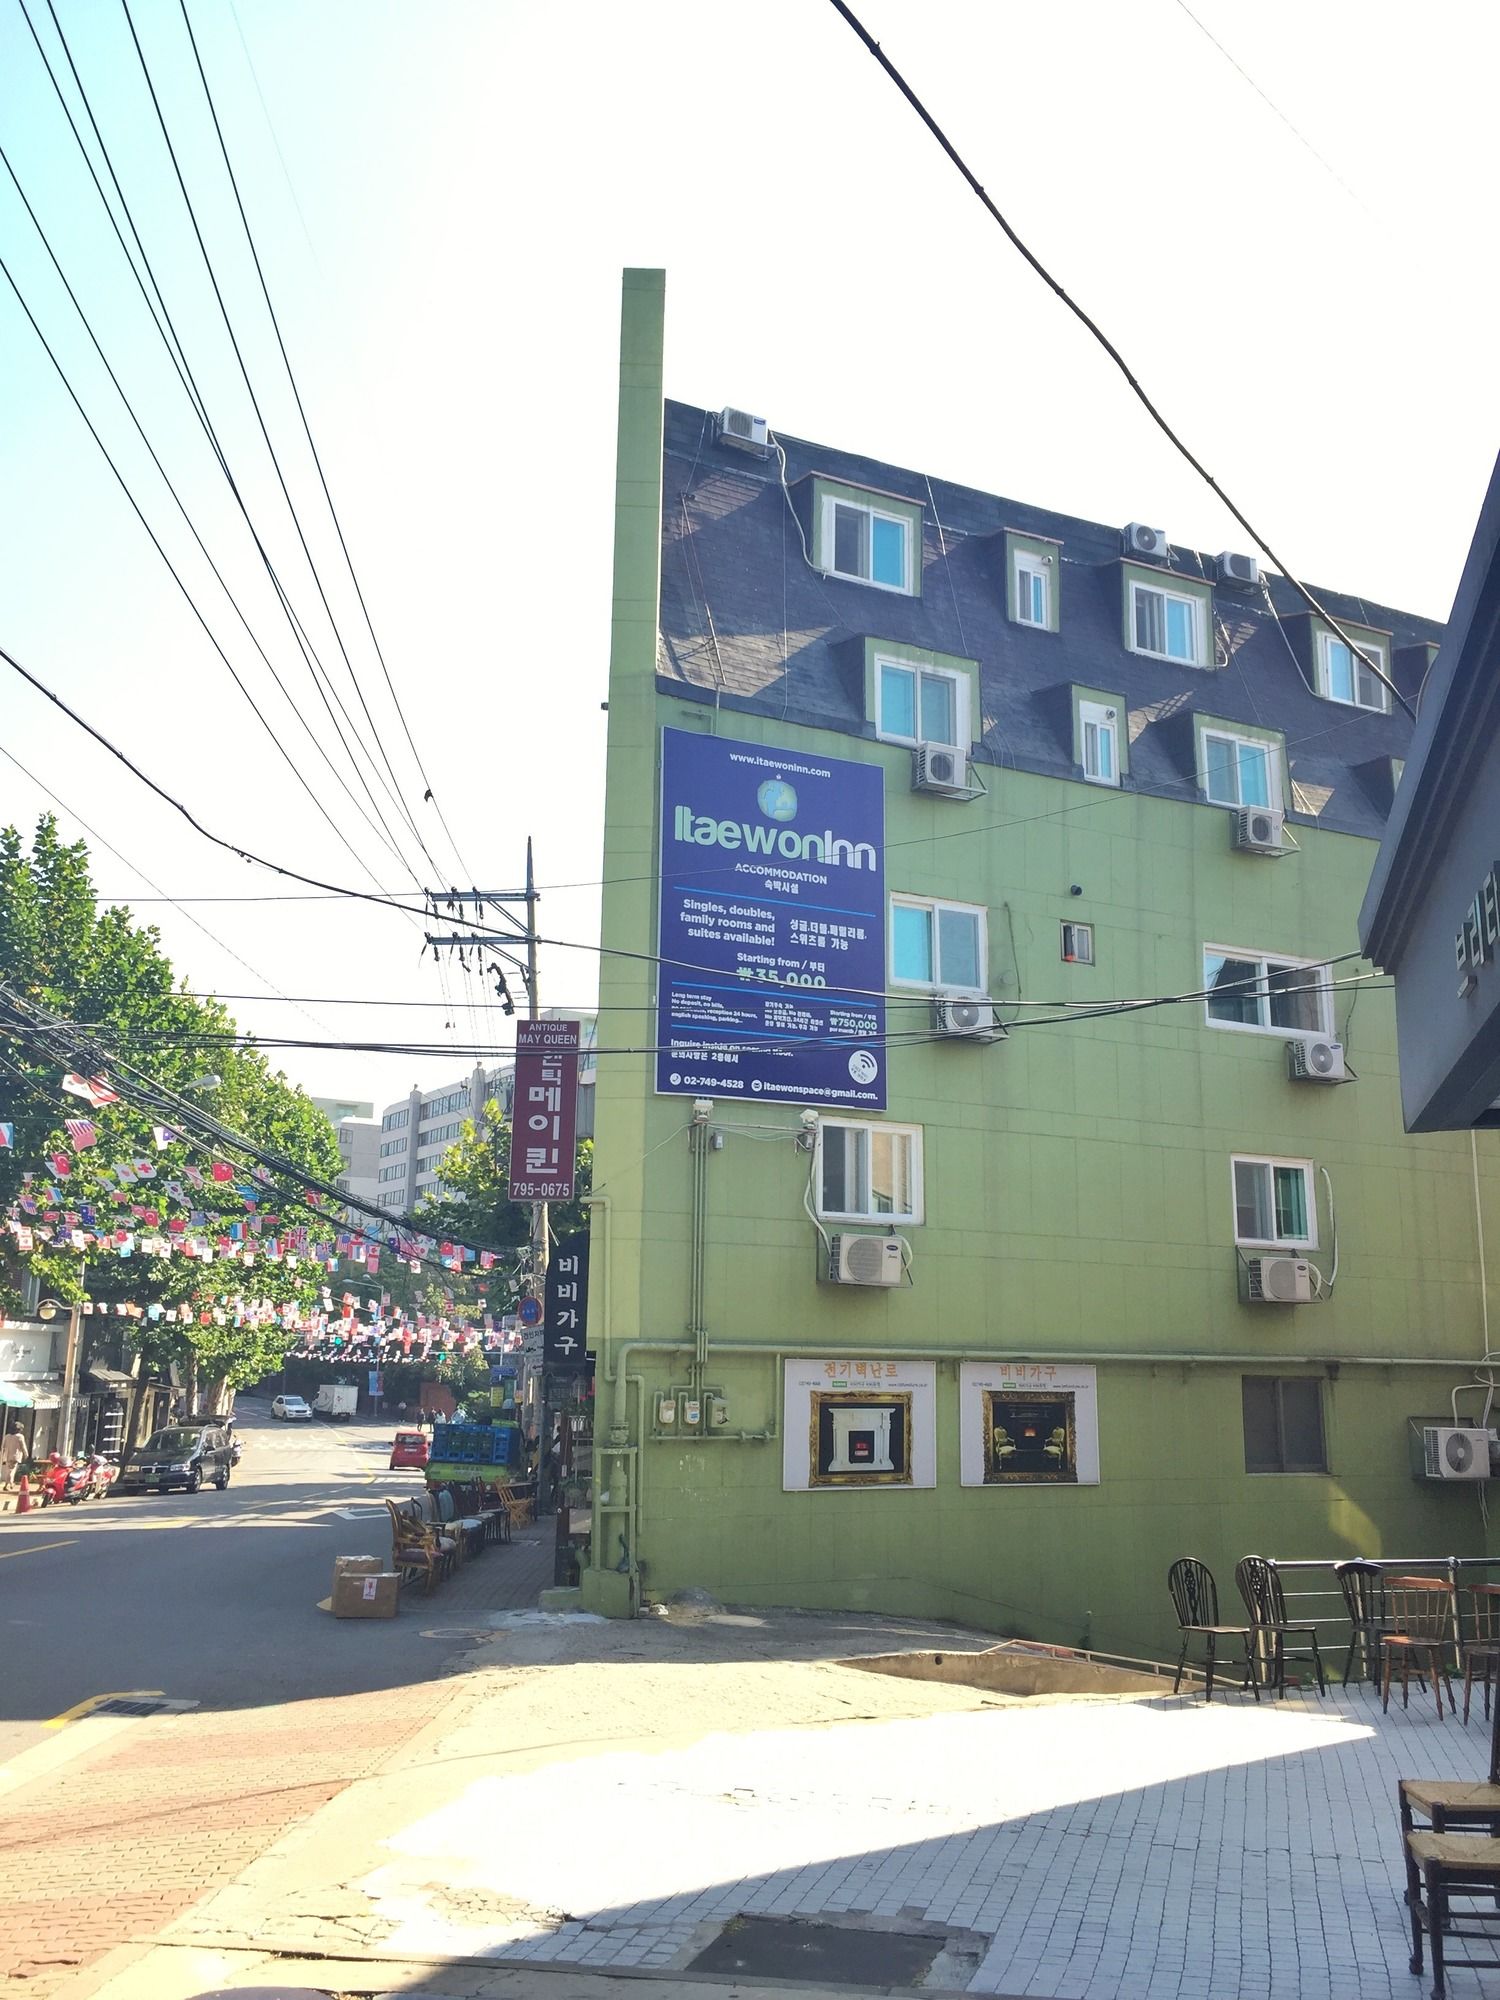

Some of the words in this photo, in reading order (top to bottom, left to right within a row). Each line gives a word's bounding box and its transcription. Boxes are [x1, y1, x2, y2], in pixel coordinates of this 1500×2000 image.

[730, 753, 831, 778] www.itaewoninn.com
[674, 805, 877, 872] ItaewonInn
[735, 863, 828, 885] ACCOMMODATION
[764, 880, 799, 895] 숙박시설
[683, 898, 727, 915] Singles,
[729, 905, 775, 921] doubles,
[680, 912, 715, 926] family
[718, 918, 753, 930] rooms
[754, 923, 775, 933] and
[688, 928, 721, 940] suites
[723, 932, 775, 946] available!
[830, 937, 849, 951] 가능
[737, 952, 775, 966] Starting
[777, 956, 800, 968] from
[809, 961, 825, 973] 부터
[529, 1023, 568, 1033] ANTIQUE
[518, 1033, 541, 1045] MAY
[543, 1033, 577, 1046] QUEEN
[684, 1076, 744, 1089] 02-749-4528
[526, 1086, 562, 1174] 메이퀸
[512, 1182, 570, 1197] 795-0675
[554, 1255, 579, 1356] 비비가구
[824, 1361, 898, 1379] 전기벽난로
[999, 1364, 1057, 1381] 비비가구
